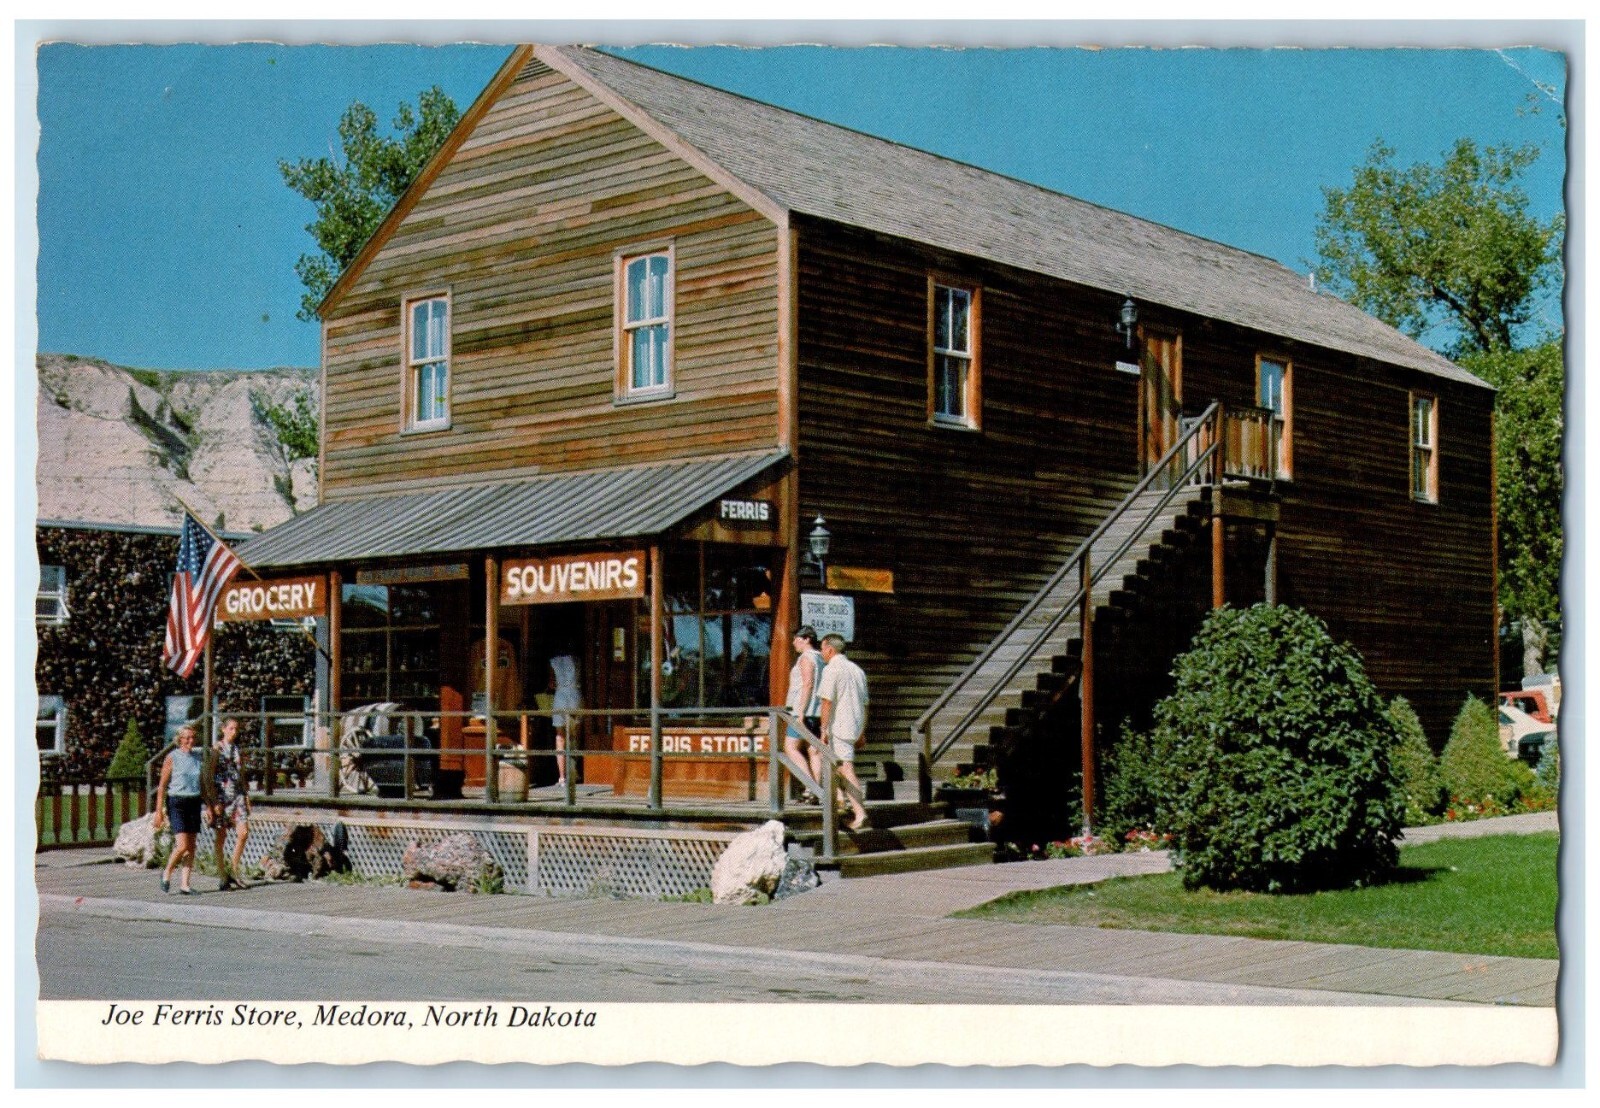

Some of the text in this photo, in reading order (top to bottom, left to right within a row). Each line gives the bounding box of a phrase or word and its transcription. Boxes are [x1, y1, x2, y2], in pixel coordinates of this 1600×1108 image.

[721, 500, 769, 520] FERRIS
[507, 557, 639, 596] SOUVENIRS
[225, 582, 317, 614] GROCERY
[628, 734, 765, 755] FERIS STORE
